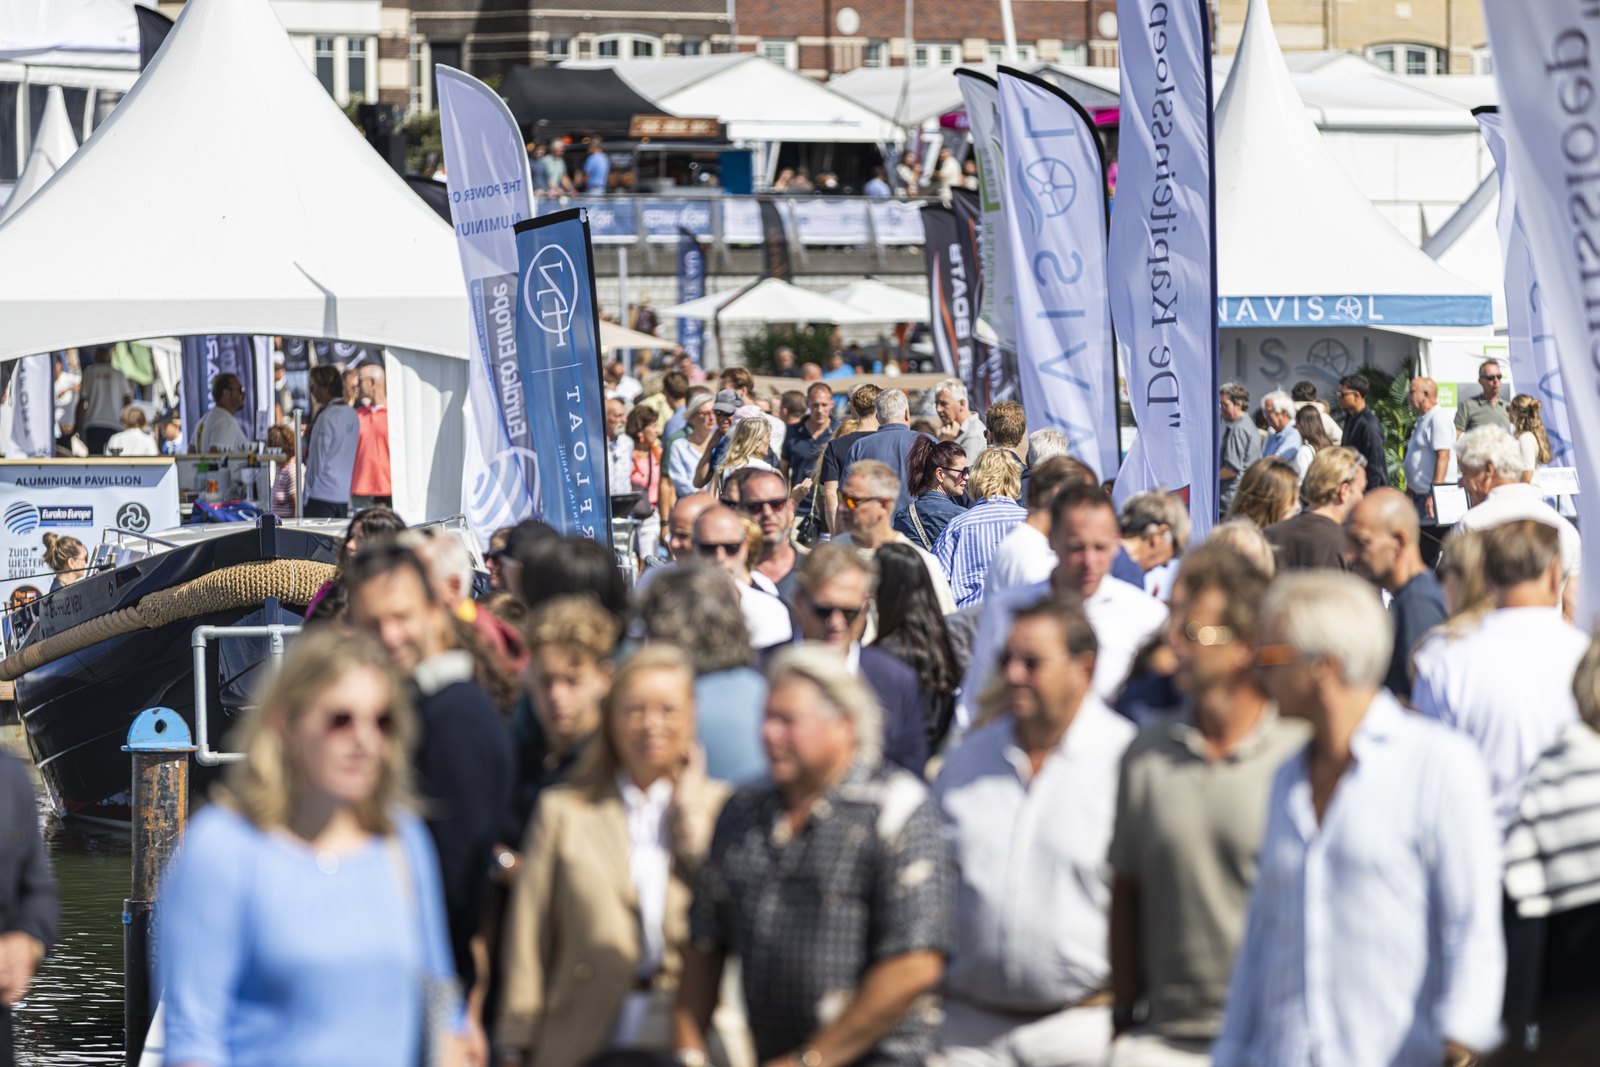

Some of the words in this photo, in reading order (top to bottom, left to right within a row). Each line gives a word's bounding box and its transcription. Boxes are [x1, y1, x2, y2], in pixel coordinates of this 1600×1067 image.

[15, 475, 81, 486] ALUMINIUM
[84, 475, 141, 486] PAVILLION
[67, 508, 92, 521] Europe
[8, 547, 29, 557] ZUID
